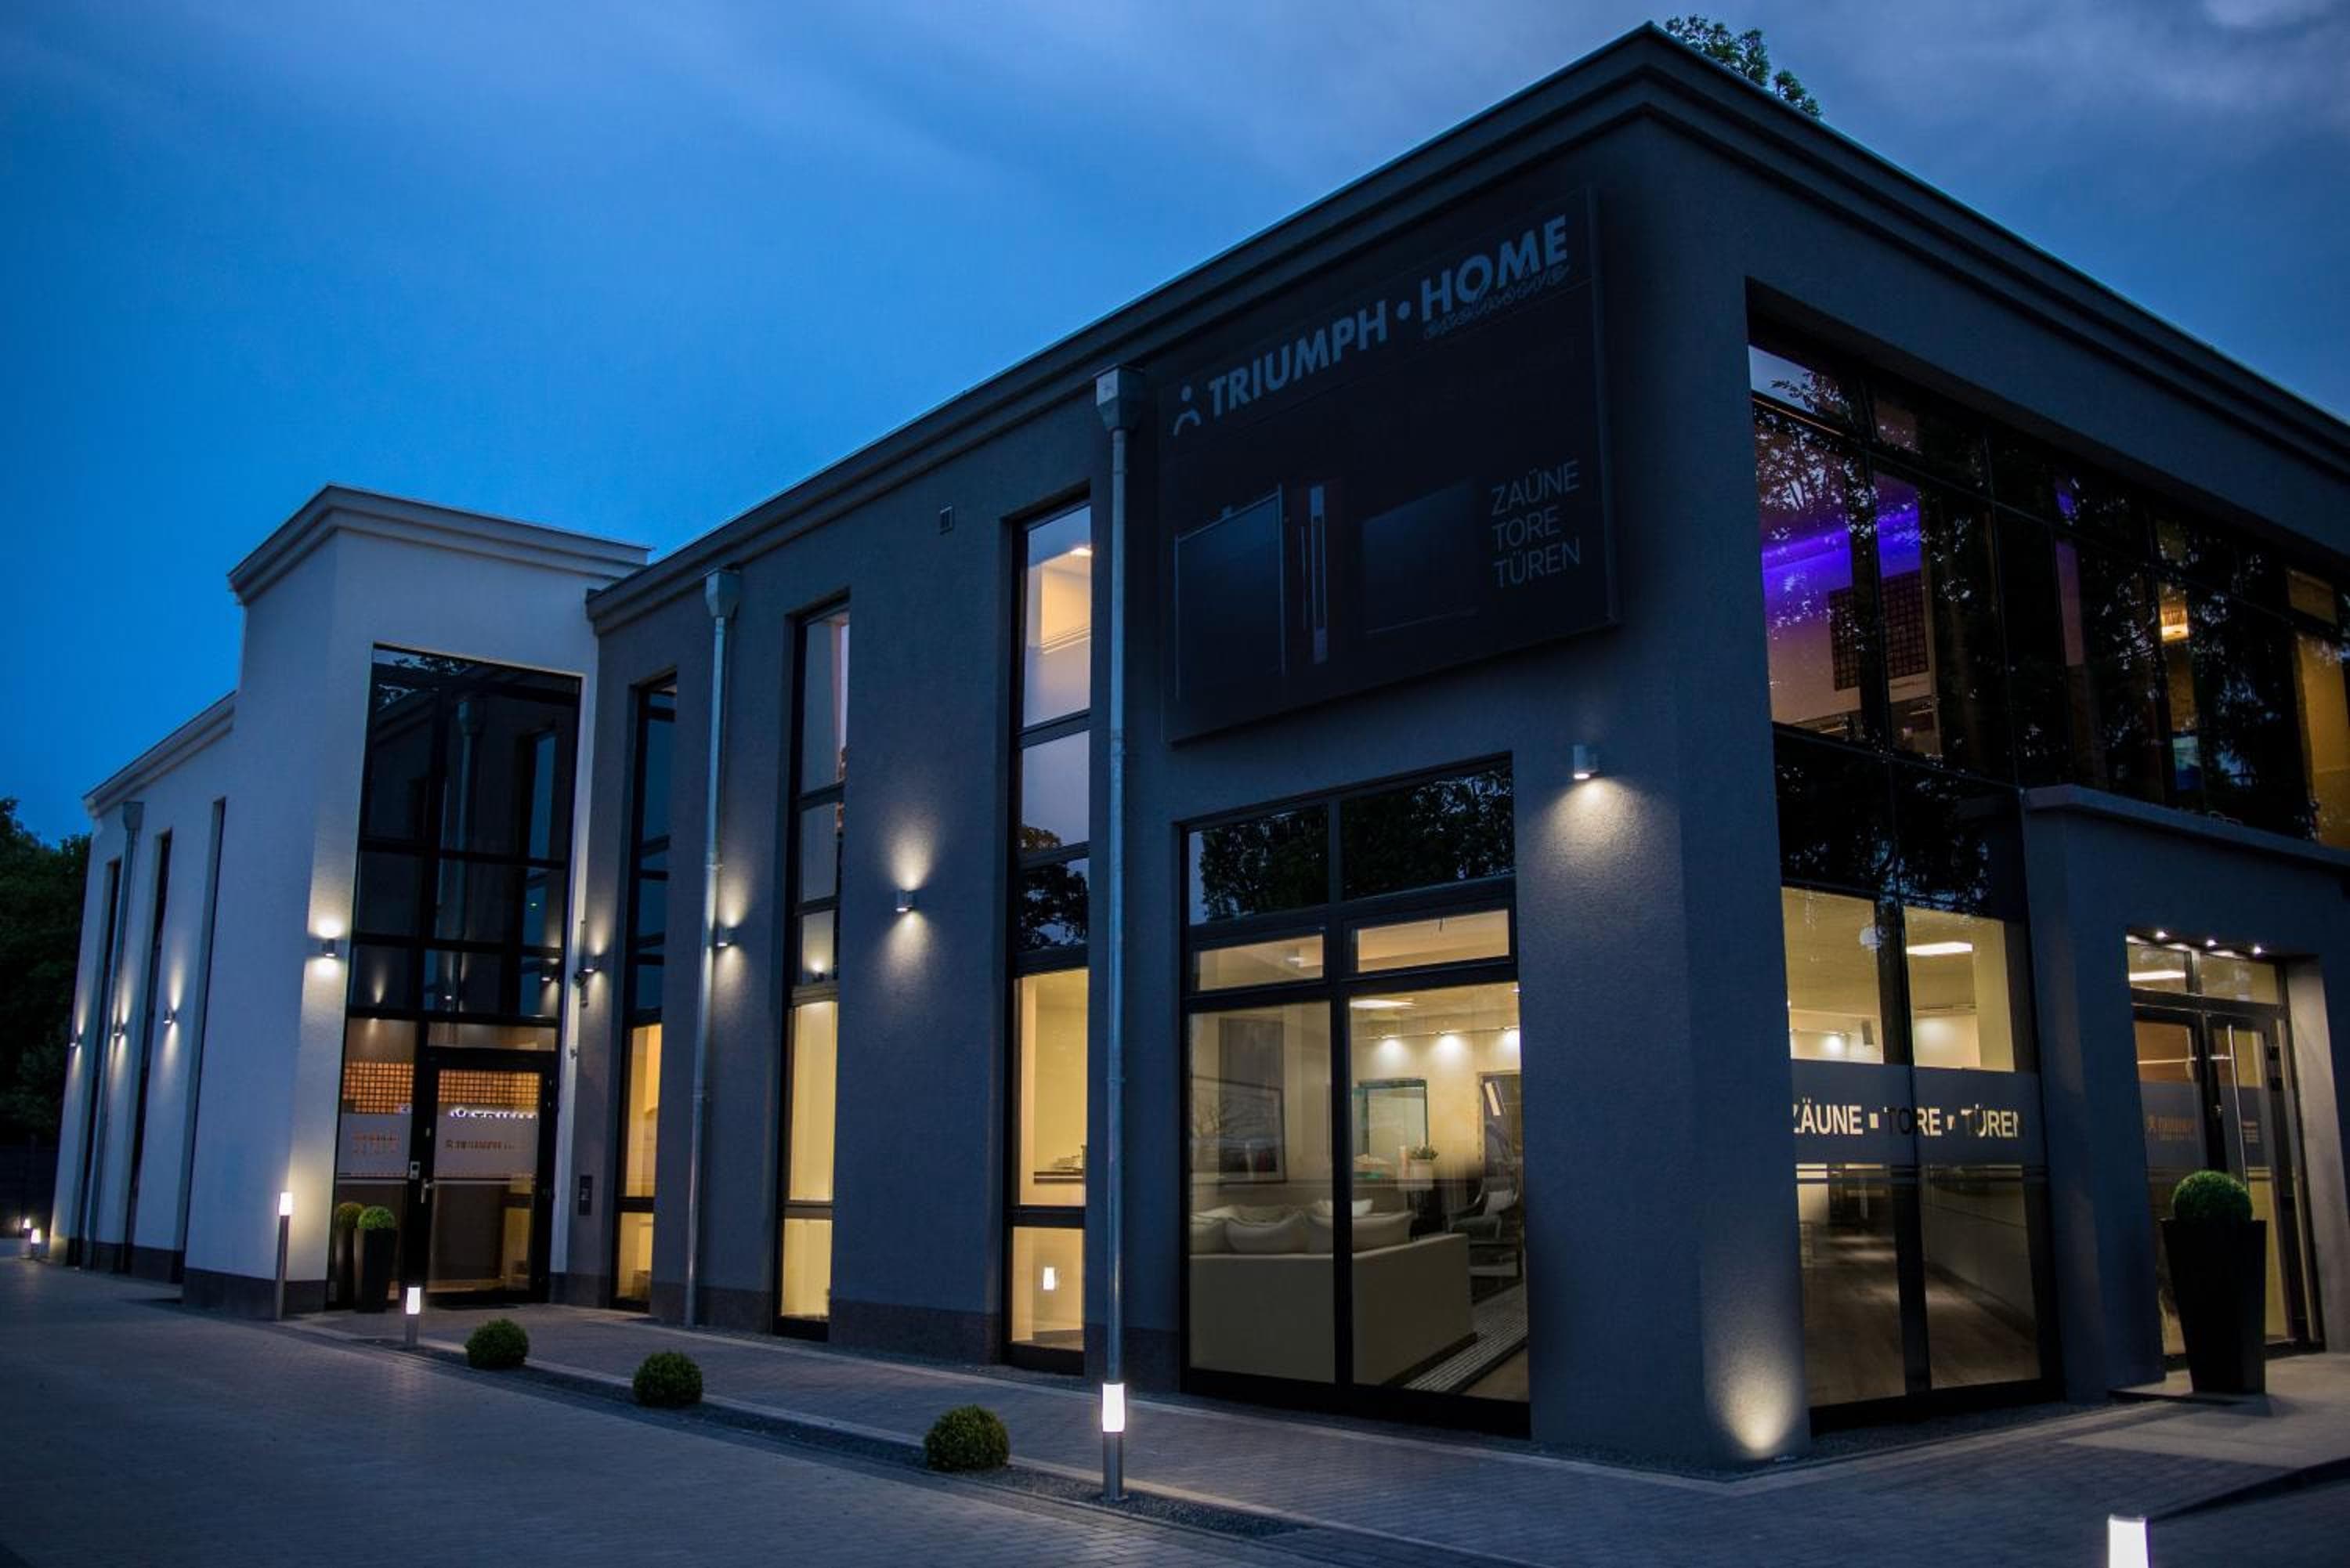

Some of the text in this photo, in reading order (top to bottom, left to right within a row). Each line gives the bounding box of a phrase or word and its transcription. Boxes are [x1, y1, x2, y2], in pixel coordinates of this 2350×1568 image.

[1209, 213, 1567, 417] TRIUMPH HOME
[1491, 458, 1580, 515] ZAÜNE
[1491, 505, 1561, 552] TORE
[1493, 537, 1580, 589] TÜREN
